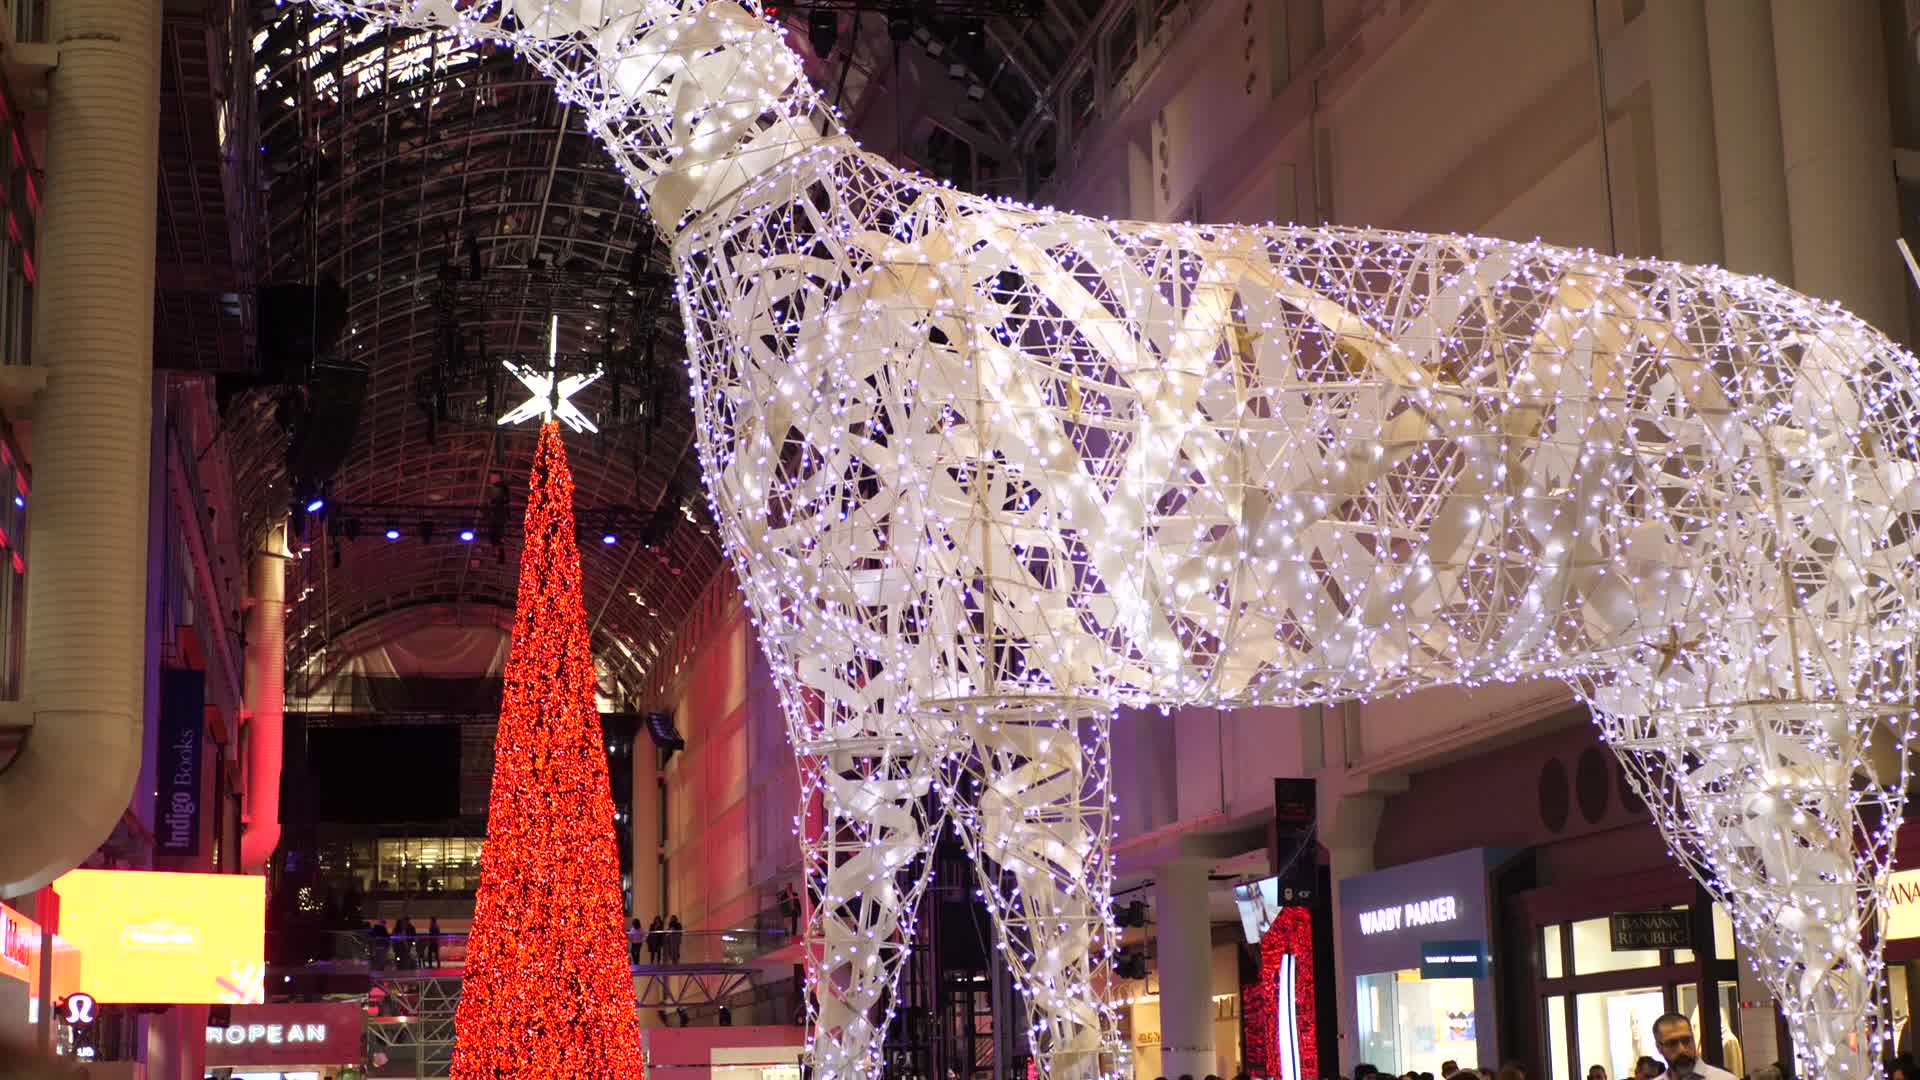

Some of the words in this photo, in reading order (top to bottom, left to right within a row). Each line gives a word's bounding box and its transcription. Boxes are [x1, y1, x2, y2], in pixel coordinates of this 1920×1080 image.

[173, 728, 193, 785] Books
[164, 791, 195, 848] Indigo
[1359, 906, 1402, 935] WARBY
[1404, 896, 1457, 928] PARKER
